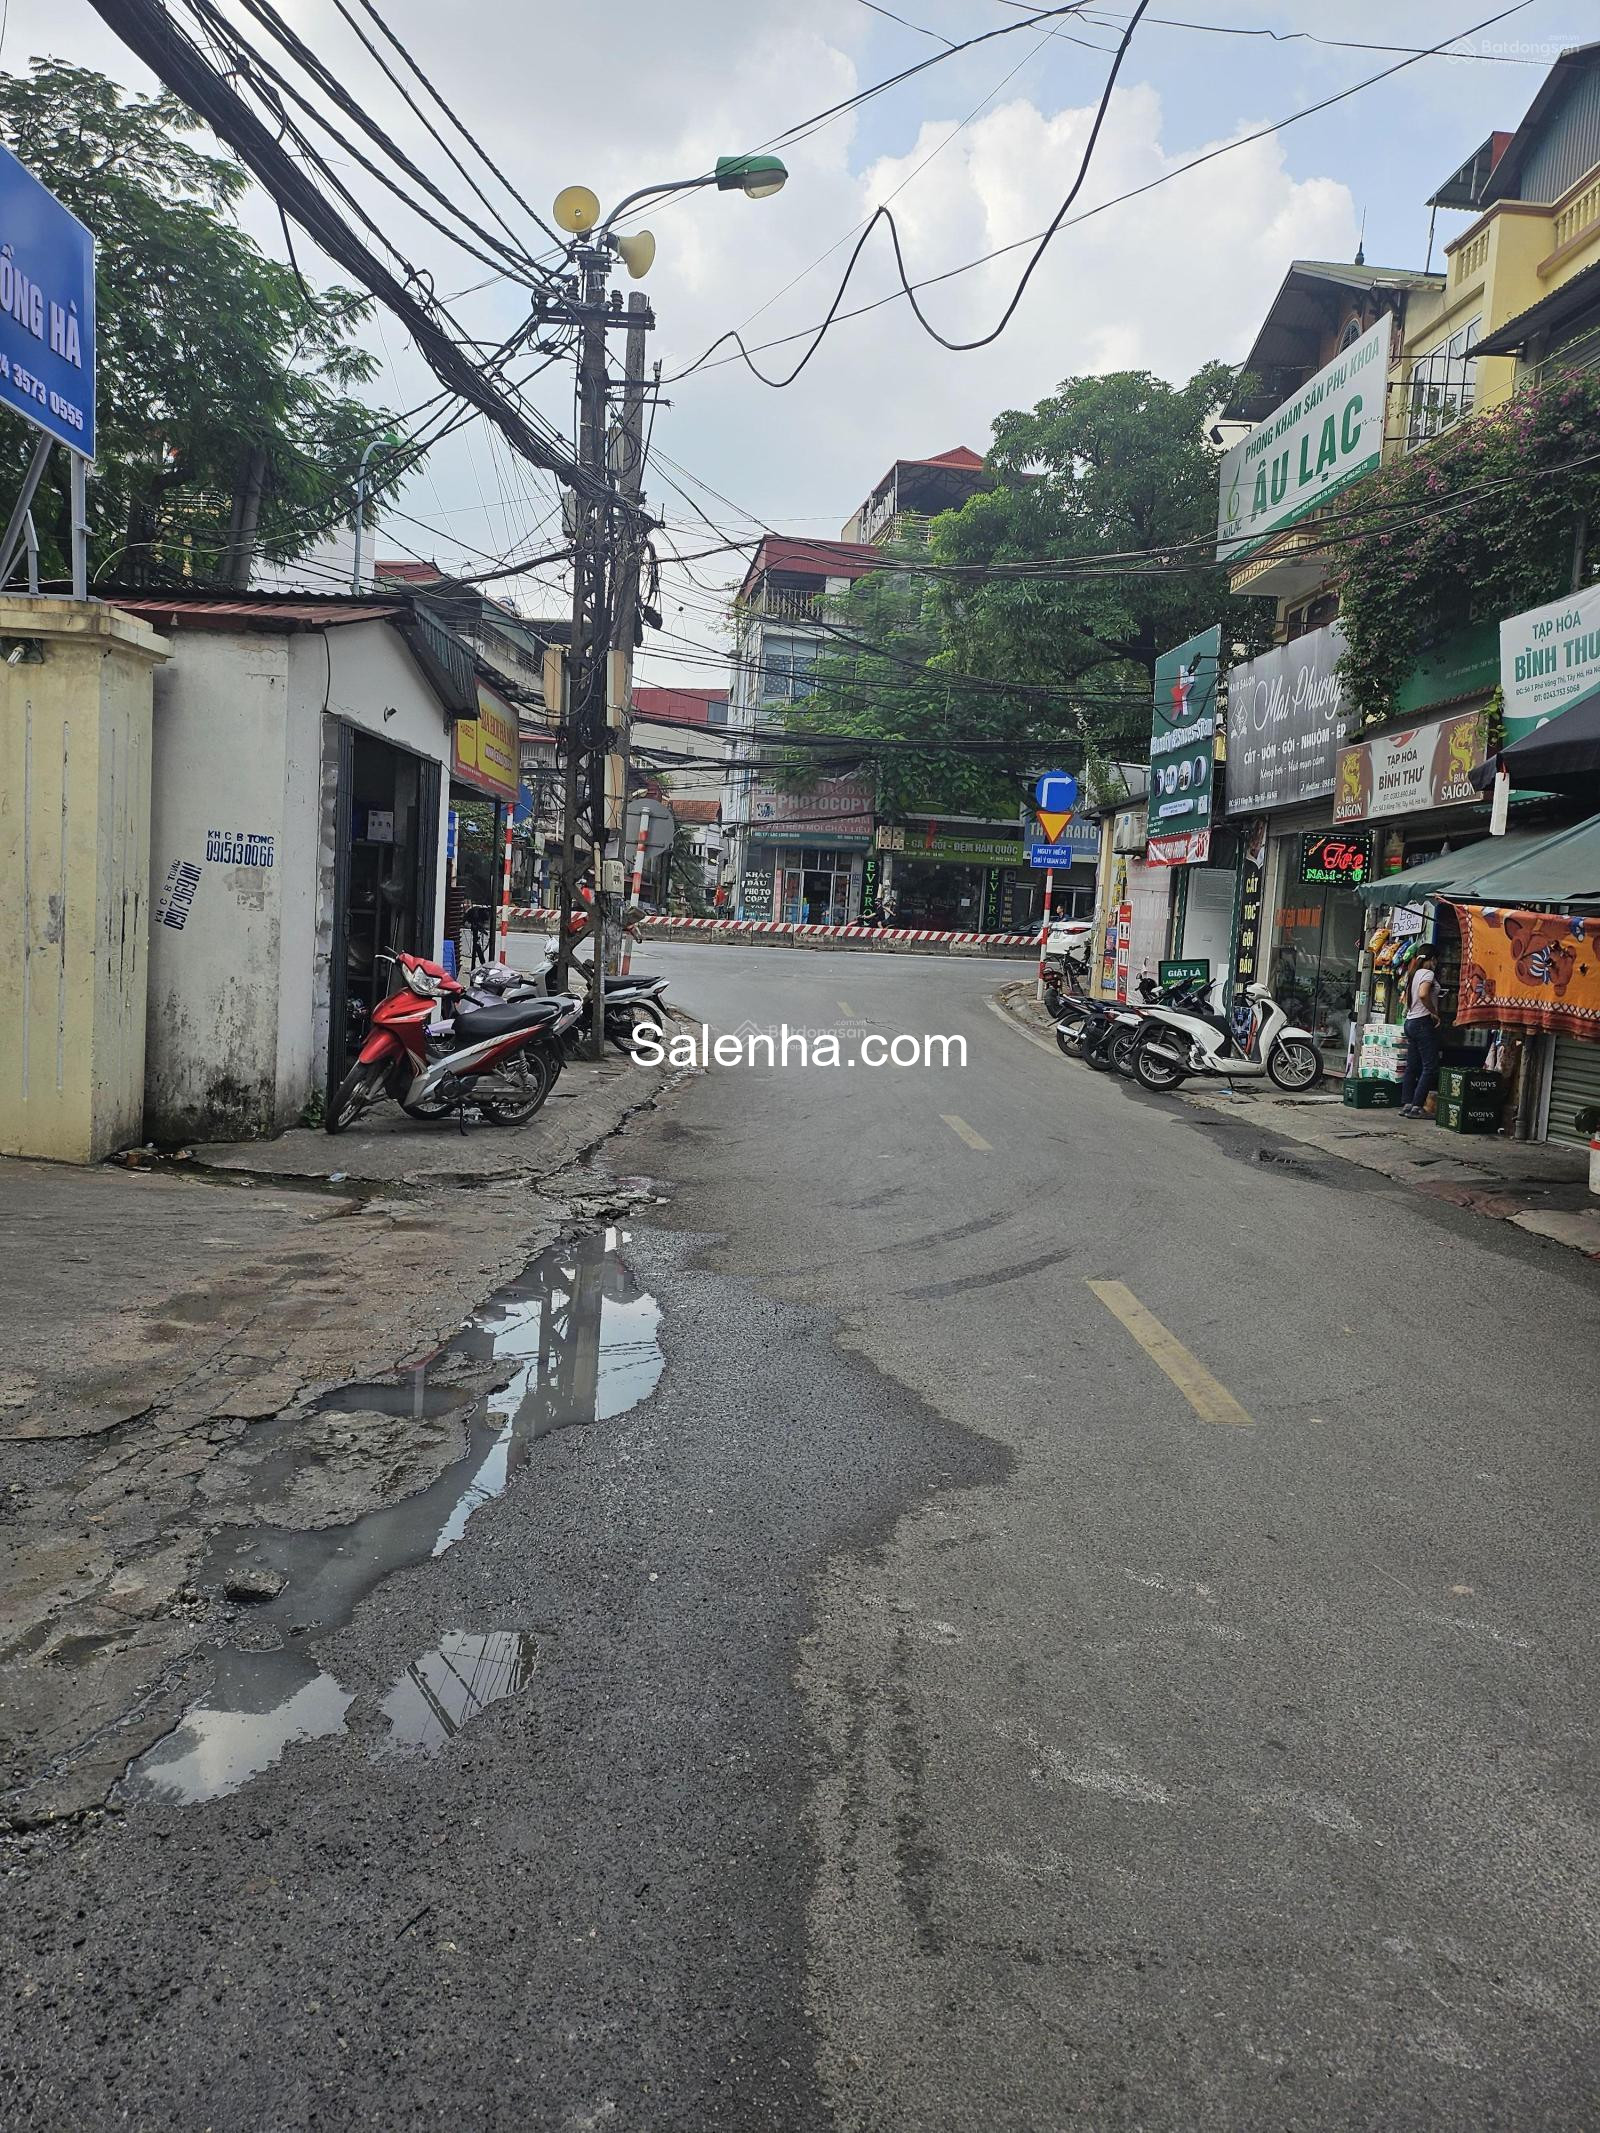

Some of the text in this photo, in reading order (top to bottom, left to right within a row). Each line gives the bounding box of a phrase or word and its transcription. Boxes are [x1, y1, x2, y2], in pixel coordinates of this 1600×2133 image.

[50, 299, 81, 369] HÀ
[13, 363, 47, 405] 3573
[50, 391, 84, 431] 0555
[1245, 336, 1380, 464] PHÒNG KHÁM SẢN PHỤ KHOA
[1251, 449, 1289, 522] ÂU
[1299, 394, 1363, 488] LẠC
[1532, 609, 1582, 643] TẠP HÓA
[1514, 645, 1557, 683] BÌNH
[1261, 742, 1277, 761] UỐN
[1282, 736, 1296, 756] GỘI
[1301, 727, 1330, 750] NHUỘM
[1387, 747, 1418, 769] TẠP HÓA
[1378, 765, 1424, 791] BÌNH THƯ
[777, 795, 871, 811] PHOTOCOPY
[1440, 783, 1476, 801] SAIGON
[1336, 803, 1363, 819] SAIGON
[207, 829, 221, 840] KH
[224, 831, 232, 841] C
[236, 833, 244, 842] B
[206, 840, 274, 868] 0915130066
[994, 841, 1018, 856] QUỐC
[1246, 871, 1259, 894] CẮT
[744, 895, 770, 904] COPY
[1244, 901, 1256, 920] TÓC
[1242, 928, 1254, 950] GỘI
[1190, 967, 1201, 976] LÀ
[1470, 1080, 1497, 1088] SAIGON
[1468, 1111, 1495, 1119] SAIGON
